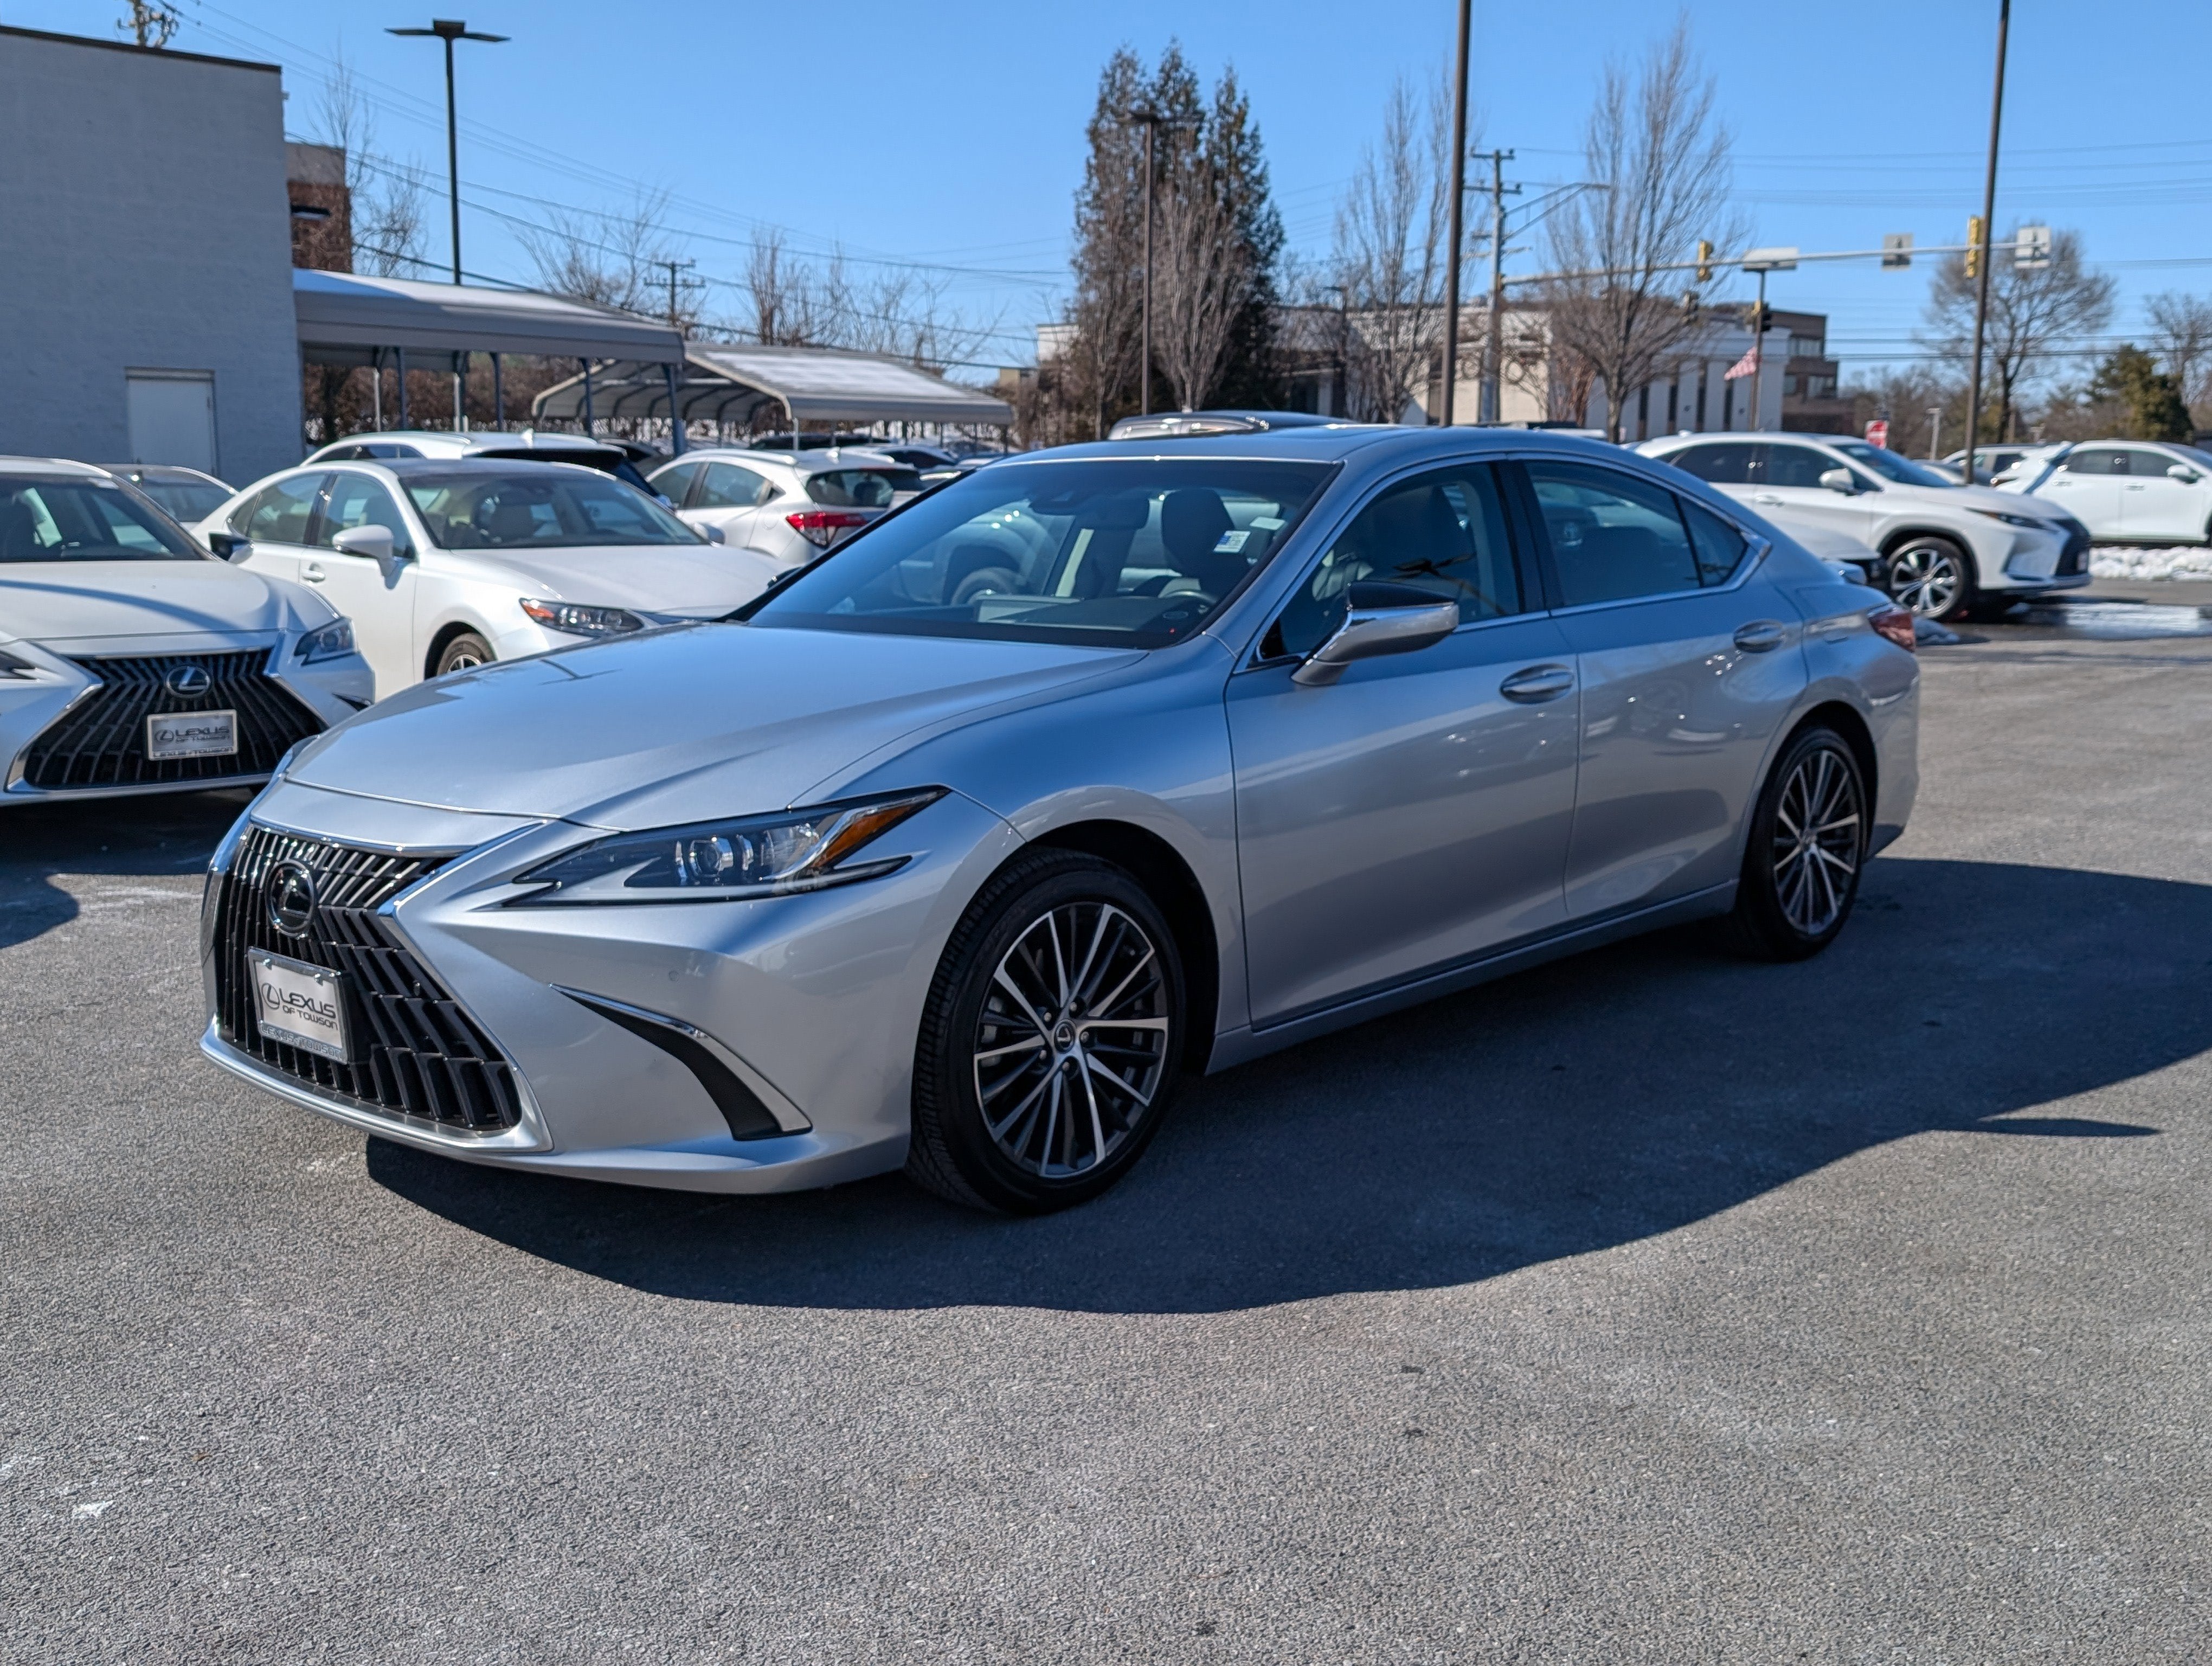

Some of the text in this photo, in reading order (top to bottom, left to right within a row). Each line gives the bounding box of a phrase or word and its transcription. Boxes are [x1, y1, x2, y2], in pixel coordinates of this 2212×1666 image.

[175, 726, 230, 736] LEXUS
[279, 988, 336, 1020] LEXUS
[282, 1004, 338, 1031] OF TOWSON
[261, 1024, 343, 1061] LEXUS TOWSON
